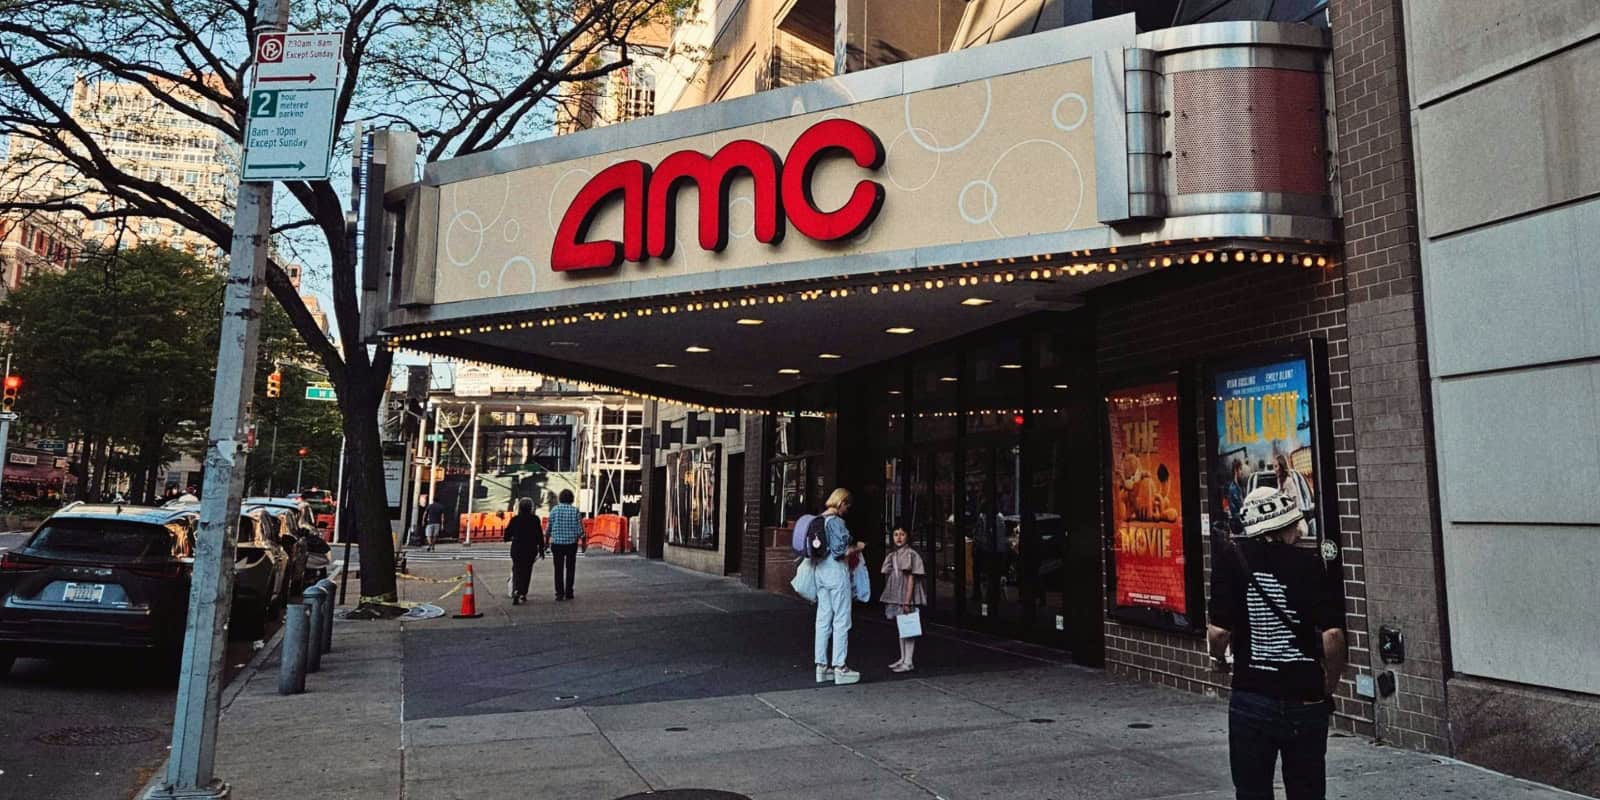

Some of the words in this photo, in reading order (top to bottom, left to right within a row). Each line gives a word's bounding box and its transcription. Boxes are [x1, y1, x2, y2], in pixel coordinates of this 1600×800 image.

[286, 51, 309, 60] Except
[310, 50, 334, 59] Sunday
[256, 92, 271, 116] 2
[280, 101, 309, 109] metered
[251, 127, 269, 136] 8am
[277, 127, 297, 137] 10pm
[250, 138, 277, 148] Except
[279, 137, 308, 147] Sunday
[1224, 398, 1258, 445] FALL
[1262, 390, 1298, 443] GUY
[1122, 419, 1159, 454] THE
[1120, 526, 1172, 559] MOVIE
